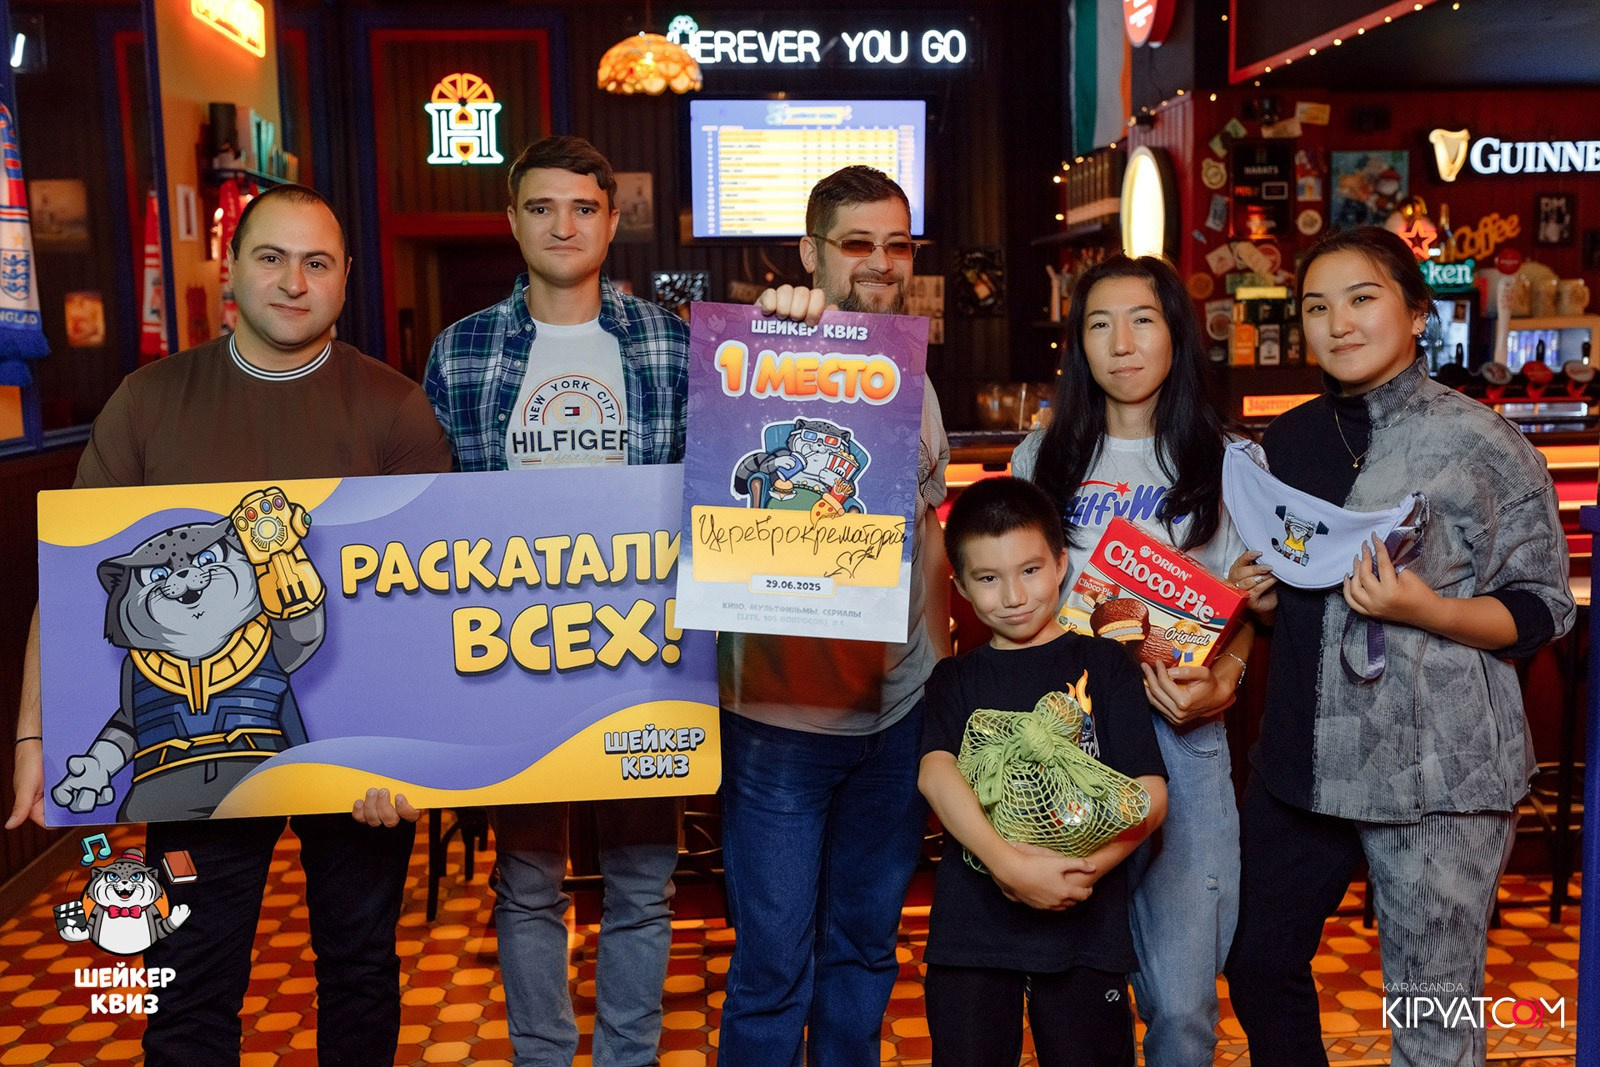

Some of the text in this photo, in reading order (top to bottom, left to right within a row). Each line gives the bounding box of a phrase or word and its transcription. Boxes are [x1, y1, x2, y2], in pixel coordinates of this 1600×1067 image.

[841, 30, 908, 63] YOU
[921, 30, 966, 63] GO
[1453, 212, 1522, 260] Coffee
[1421, 260, 1473, 284] ken
[823, 324, 868, 341] КВИЗ
[719, 345, 896, 401] 1 МЕСТО
[529, 380, 616, 421] NEW YORK CITY
[766, 579, 821, 592] 29.06.2025
[822, 608, 862, 618] СЕРИАЛЫ
[452, 597, 684, 676] ВСЕХ!
[1164, 627, 1211, 646] Original
[604, 724, 705, 754] ШЕЙКЕР
[621, 754, 690, 780] КВИЗ
